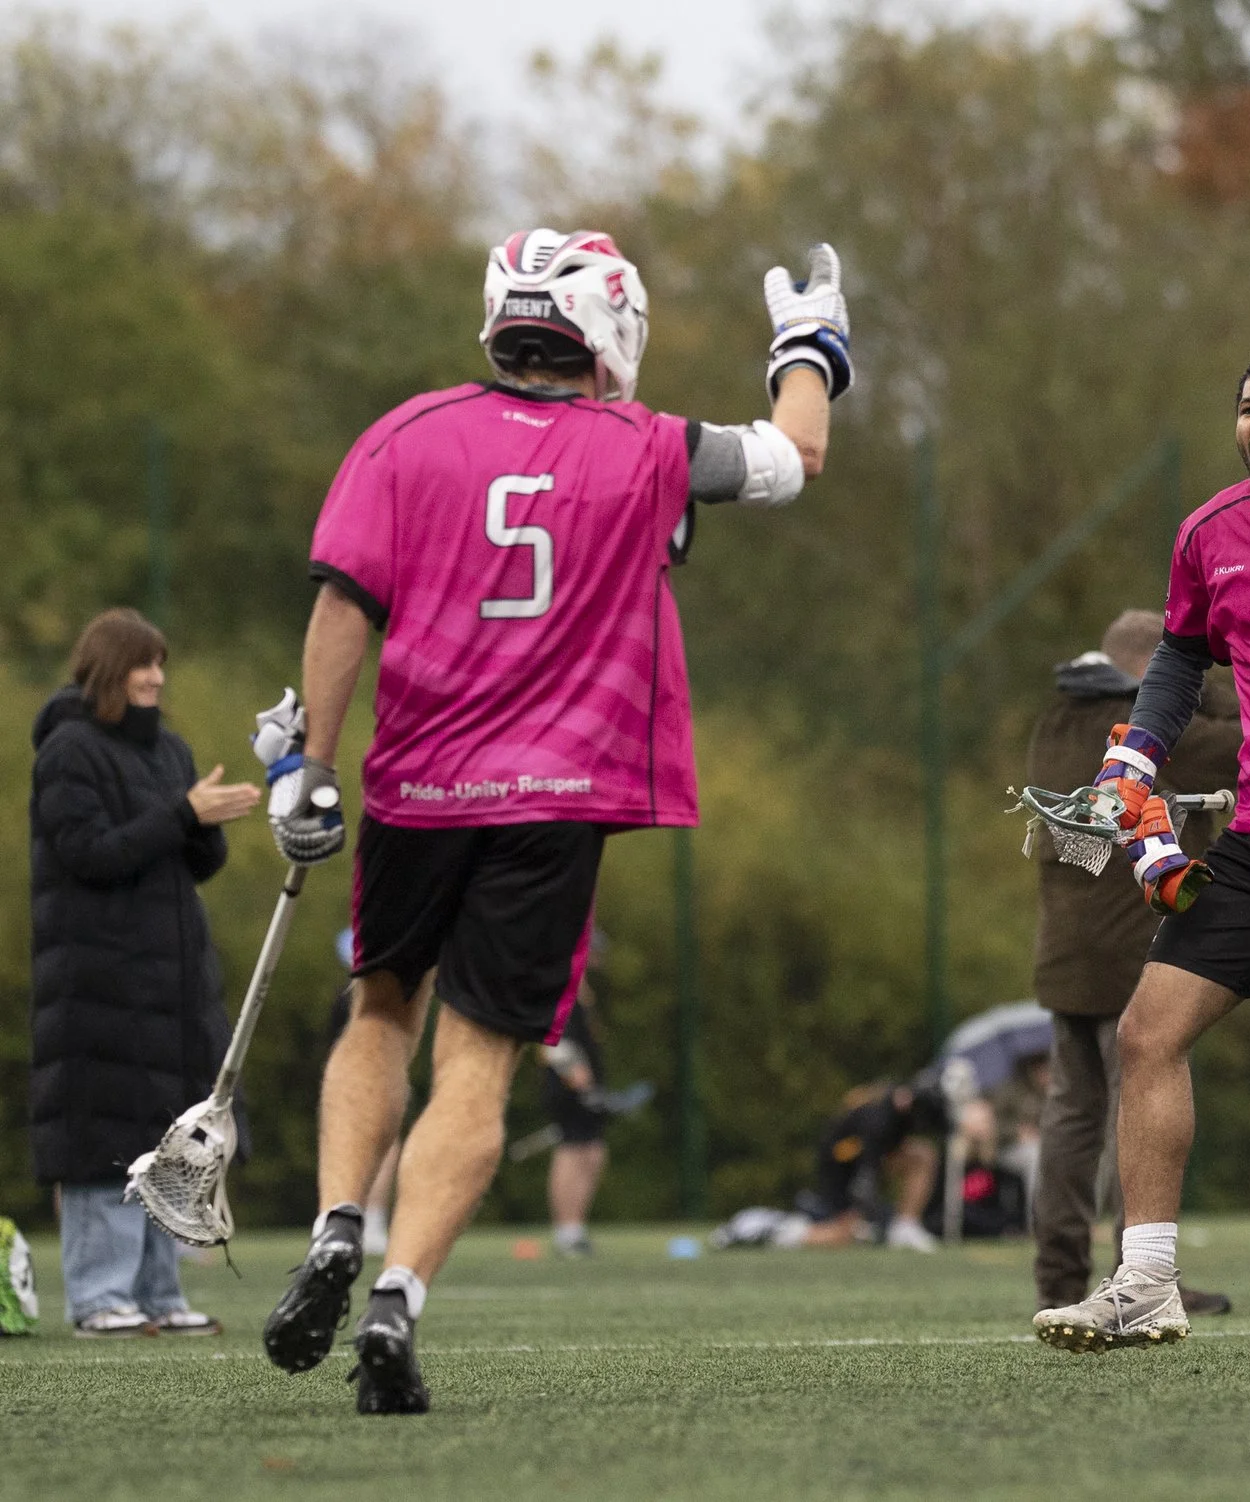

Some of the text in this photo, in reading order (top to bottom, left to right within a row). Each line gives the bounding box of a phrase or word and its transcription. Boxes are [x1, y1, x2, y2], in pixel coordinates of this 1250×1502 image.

[505, 298, 554, 318] TRENT
[479, 472, 555, 619] 5
[1219, 564, 1245, 575] KUKRI
[400, 781, 445, 800] Pride
[518, 775, 592, 795] Respect
